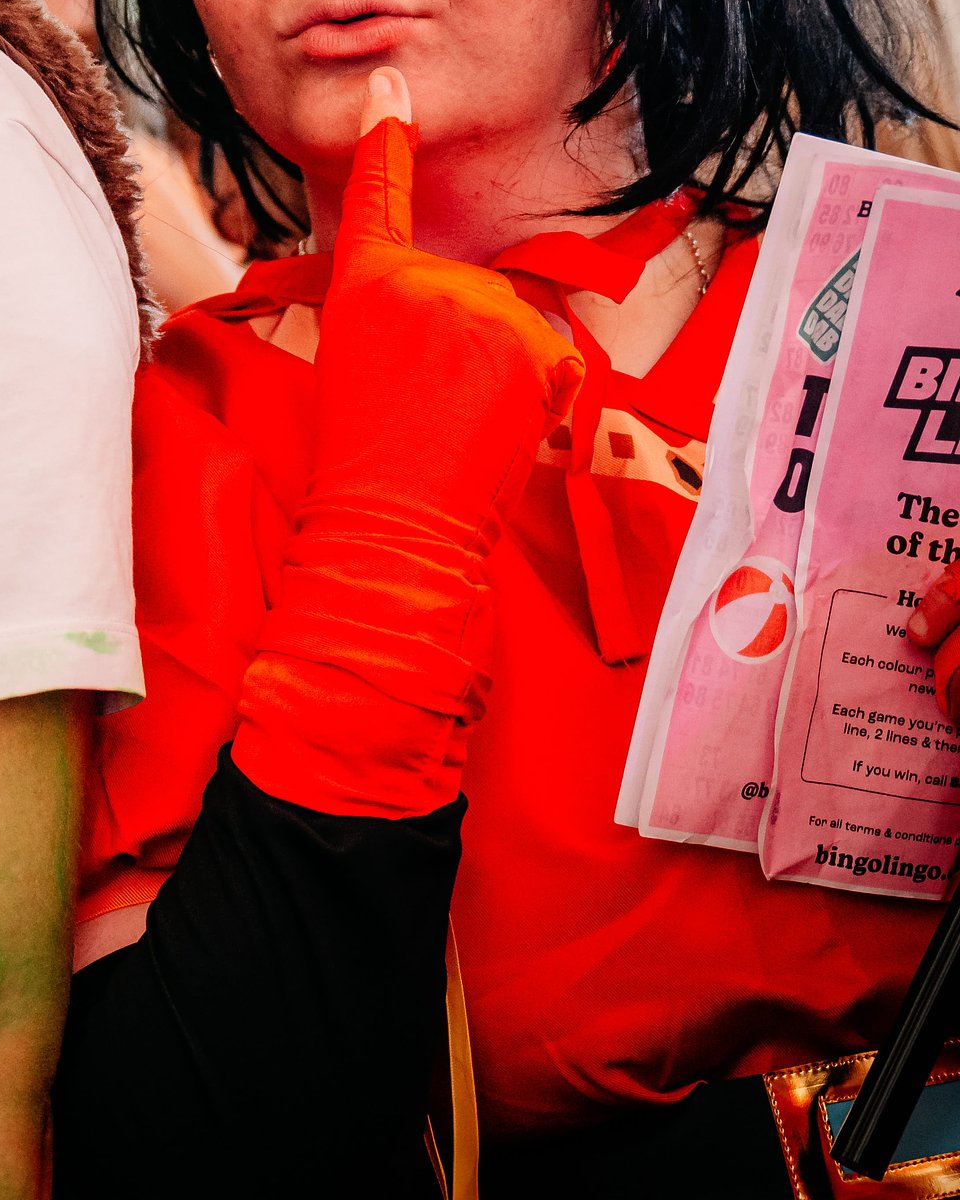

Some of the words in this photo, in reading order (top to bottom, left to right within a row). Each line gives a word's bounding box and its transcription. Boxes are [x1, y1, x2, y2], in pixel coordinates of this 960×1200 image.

[803, 310, 840, 353] DAB
[897, 491, 960, 529] The
[887, 530, 924, 559] of
[842, 652, 874, 667] Each
[878, 660, 923, 676] colour
[908, 682, 937, 697] new
[832, 704, 865, 720] Each
[868, 711, 906, 727] game
[908, 719, 954, 735] you're
[844, 722, 871, 741] line,
[874, 729, 884, 740] 2
[886, 730, 918, 746] lines
[921, 737, 932, 749] &
[852, 760, 864, 772] If
[864, 764, 890, 778] you
[893, 770, 921, 786] win,
[925, 775, 948, 788] call
[808, 815, 827, 827] For
[830, 819, 844, 830] all
[845, 821, 882, 837] terms
[884, 828, 893, 839] &
[895, 830, 953, 846] conditions
